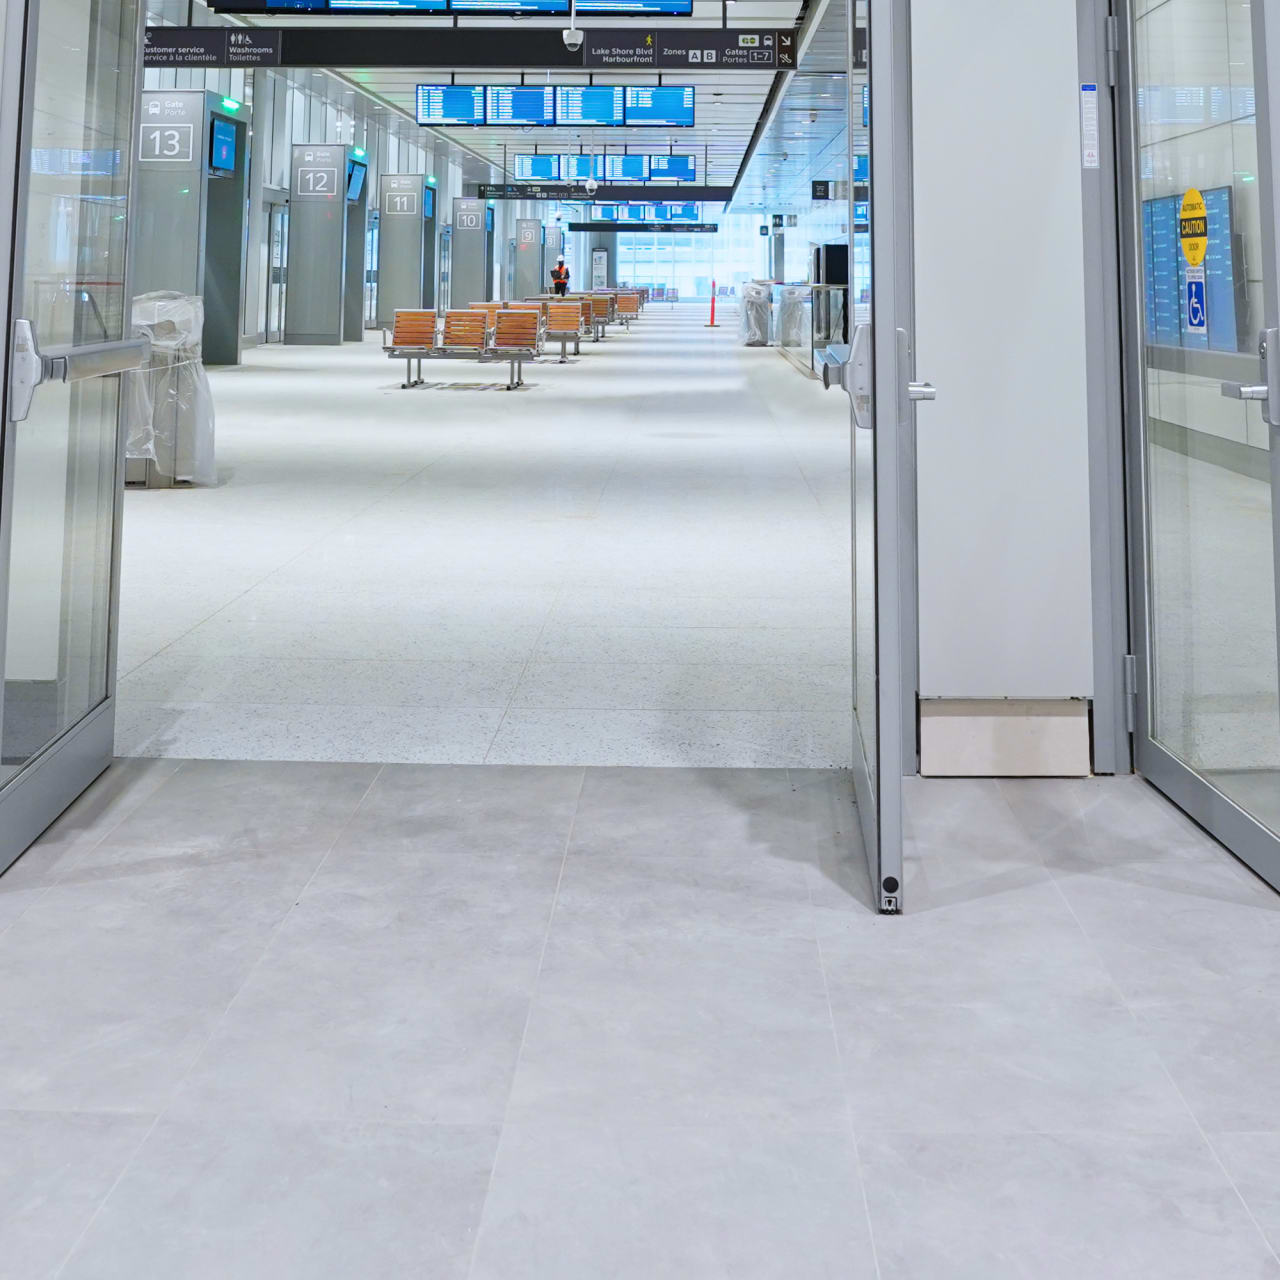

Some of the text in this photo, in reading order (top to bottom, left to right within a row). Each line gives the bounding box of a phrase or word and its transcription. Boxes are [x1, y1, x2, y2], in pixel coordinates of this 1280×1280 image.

[177, 46, 205, 54] service
[229, 46, 273, 54] Washrooms
[592, 48, 653, 56] Lake Shore Blvd
[725, 48, 748, 57] Gates
[184, 53, 217, 61] clientèle
[229, 54, 261, 62] Toilettes
[663, 48, 714, 61] Zones A B
[602, 55, 653, 63] Harbourfront
[722, 56, 748, 64] Portes
[164, 100, 184, 108] Gate
[165, 108, 186, 116] Porte
[149, 130, 180, 156] 13
[305, 172, 328, 191] 12
[393, 197, 407, 211] 11
[462, 215, 476, 227] 10
[1181, 220, 1205, 234] CAUTION
[525, 231, 532, 241] 9
